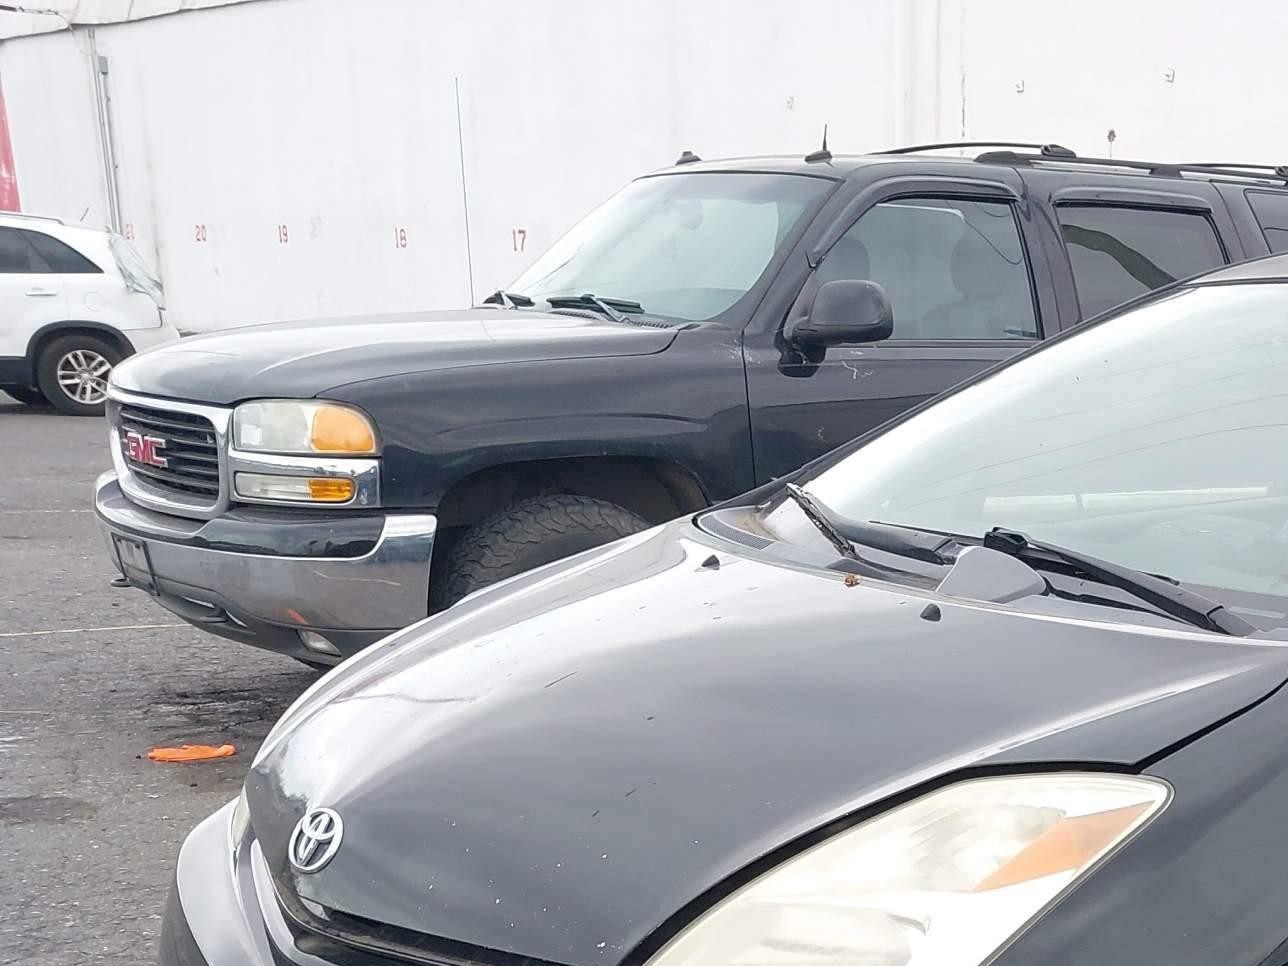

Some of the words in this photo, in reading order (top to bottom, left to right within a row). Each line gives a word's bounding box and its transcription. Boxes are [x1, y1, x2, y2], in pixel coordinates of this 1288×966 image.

[195, 224, 207, 242] 20
[278, 224, 288, 244] 19
[394, 227, 407, 248] 18
[512, 229, 526, 251] 17
[126, 431, 168, 468] GMC
